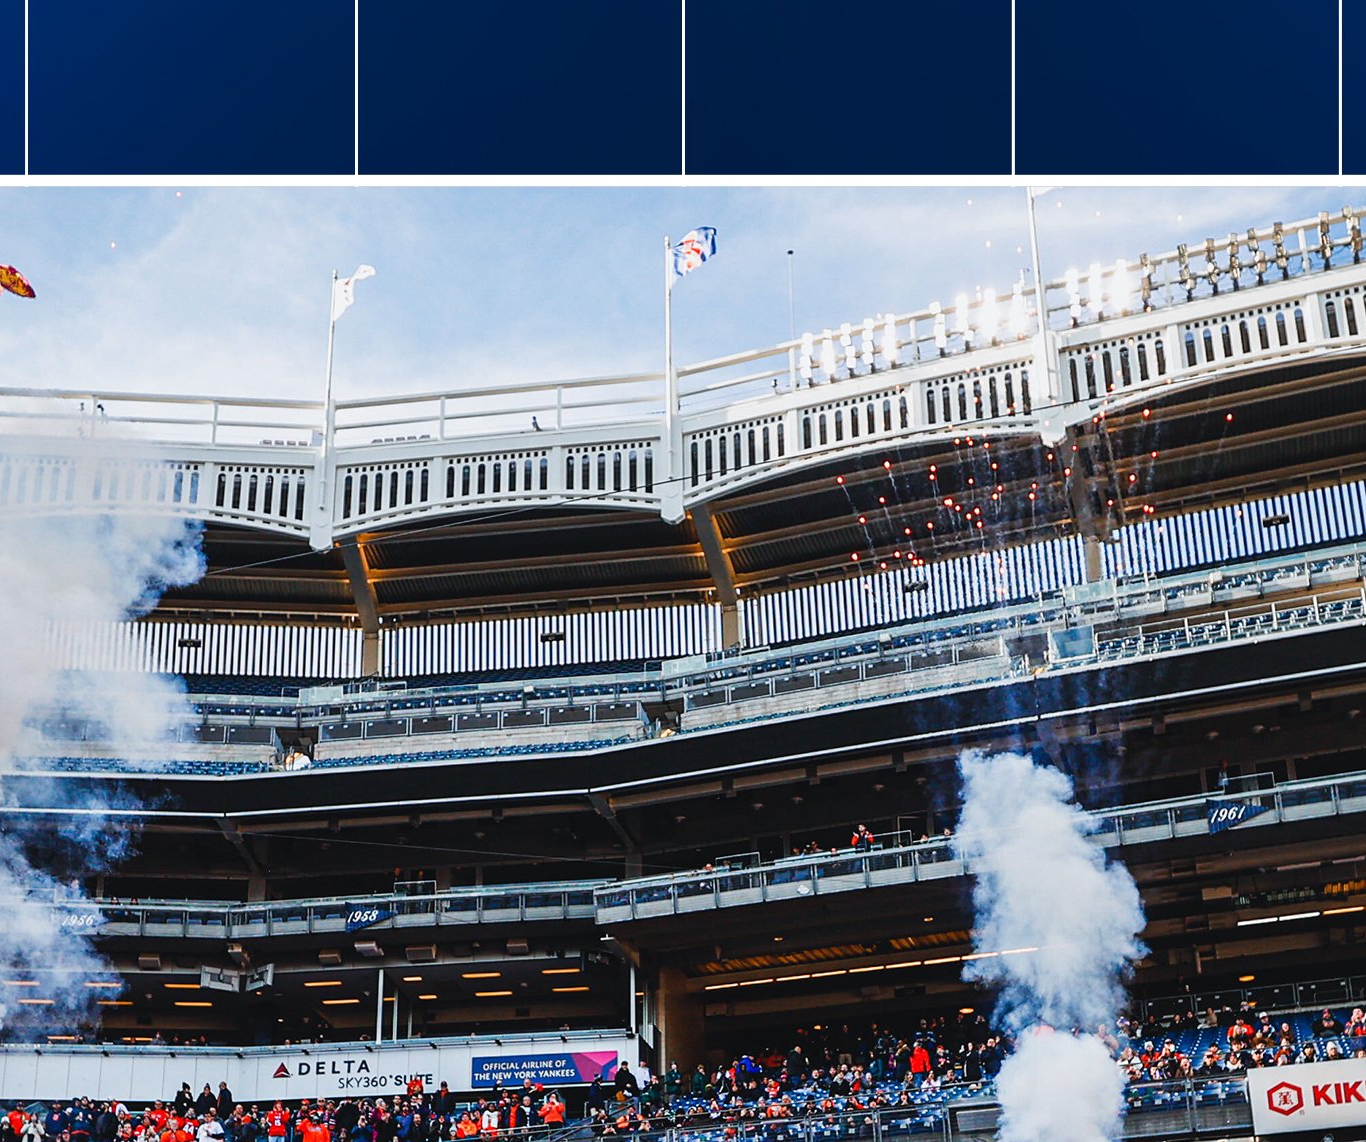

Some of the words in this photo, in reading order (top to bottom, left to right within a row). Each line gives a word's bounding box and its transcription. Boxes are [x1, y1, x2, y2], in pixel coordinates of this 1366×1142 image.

[1210, 805, 1246, 823] 1961
[347, 908, 378, 924] 1958
[298, 1060, 370, 1076] DELTA
[483, 1062, 519, 1071] OFFICIAL
[522, 1061, 552, 1070] AIRLINE
[555, 1060, 566, 1068] OF
[474, 1072, 487, 1080] THE
[490, 1071, 510, 1080] NEW
[512, 1070, 534, 1079] YORK
[536, 1068, 575, 1077] YANKEES
